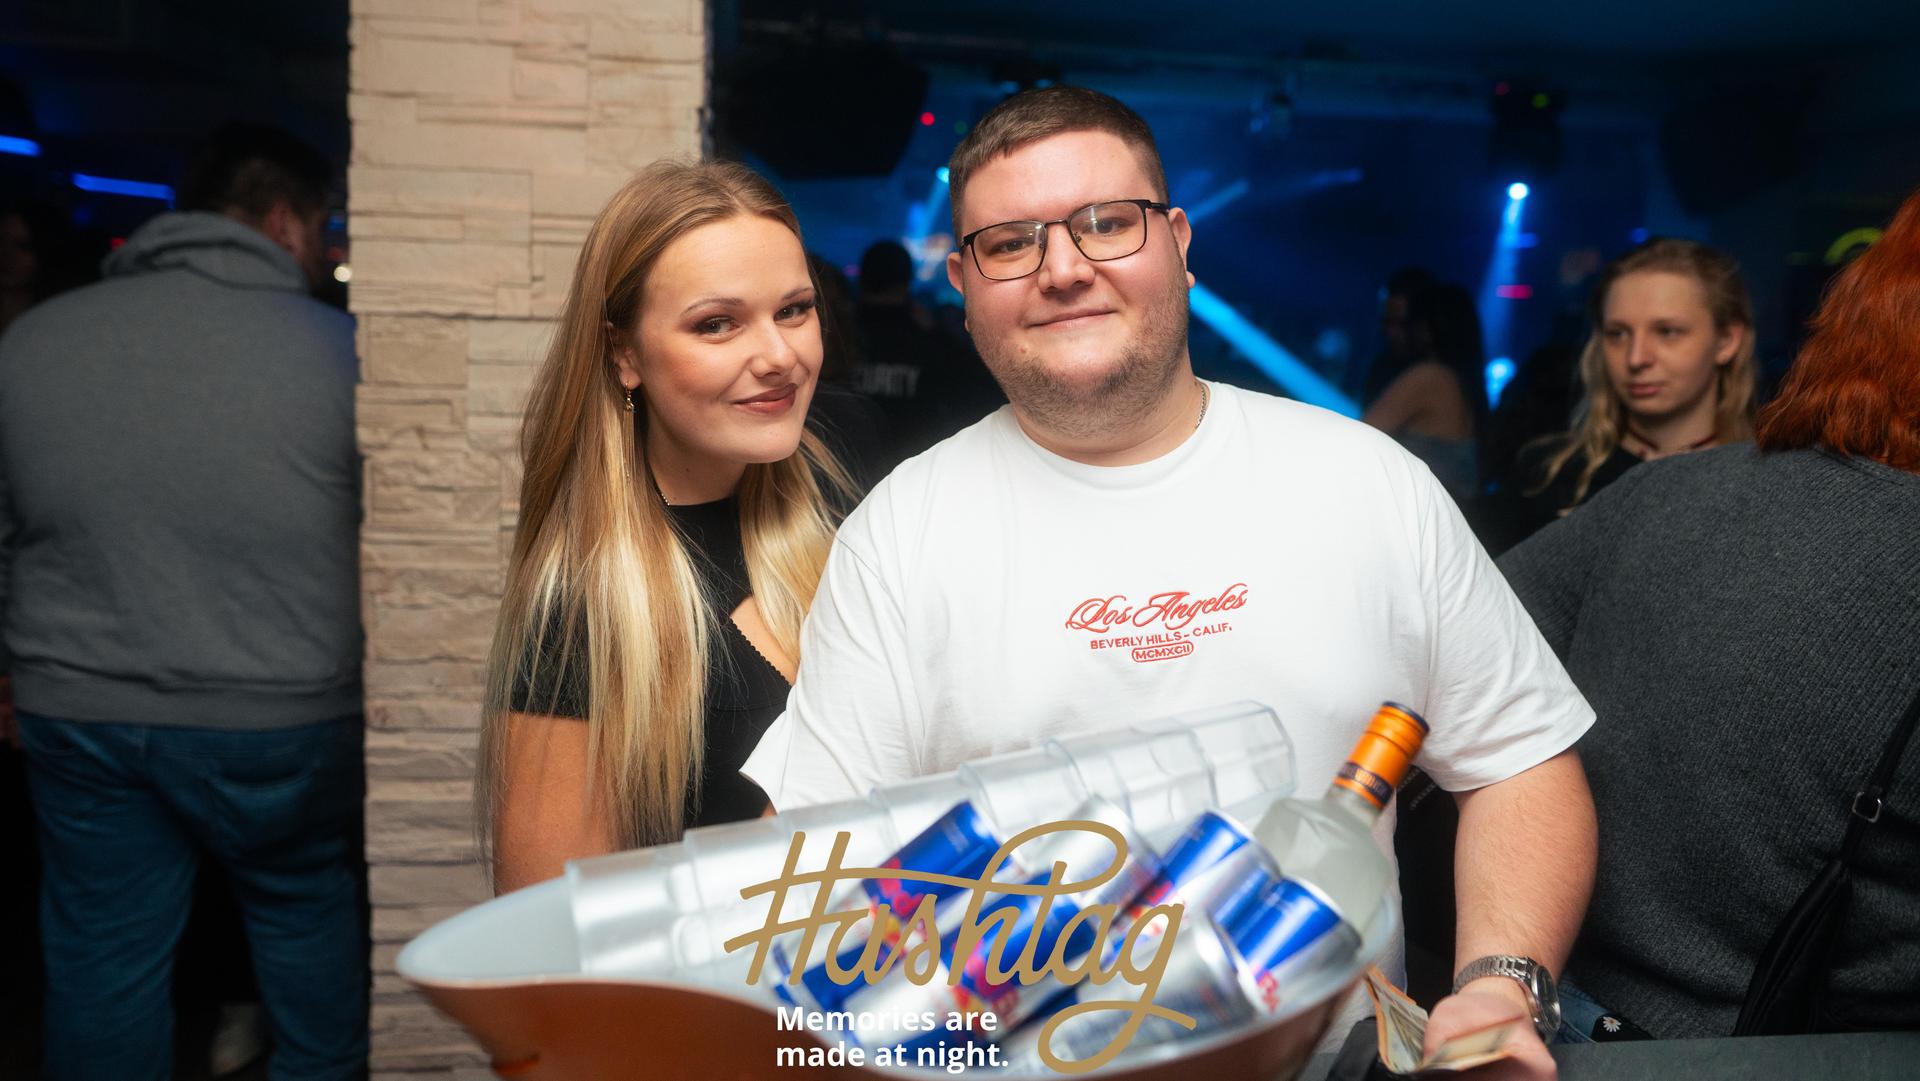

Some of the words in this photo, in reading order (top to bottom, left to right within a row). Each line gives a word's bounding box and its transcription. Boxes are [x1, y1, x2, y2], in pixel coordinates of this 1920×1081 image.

[1065, 595, 1133, 633] Los
[1133, 583, 1249, 630] Angeles
[1090, 635, 1143, 650] BEVERLY
[1146, 631, 1182, 645] HILLS
[1192, 622, 1233, 637] CALIF.
[1134, 643, 1192, 661] MCMXCII
